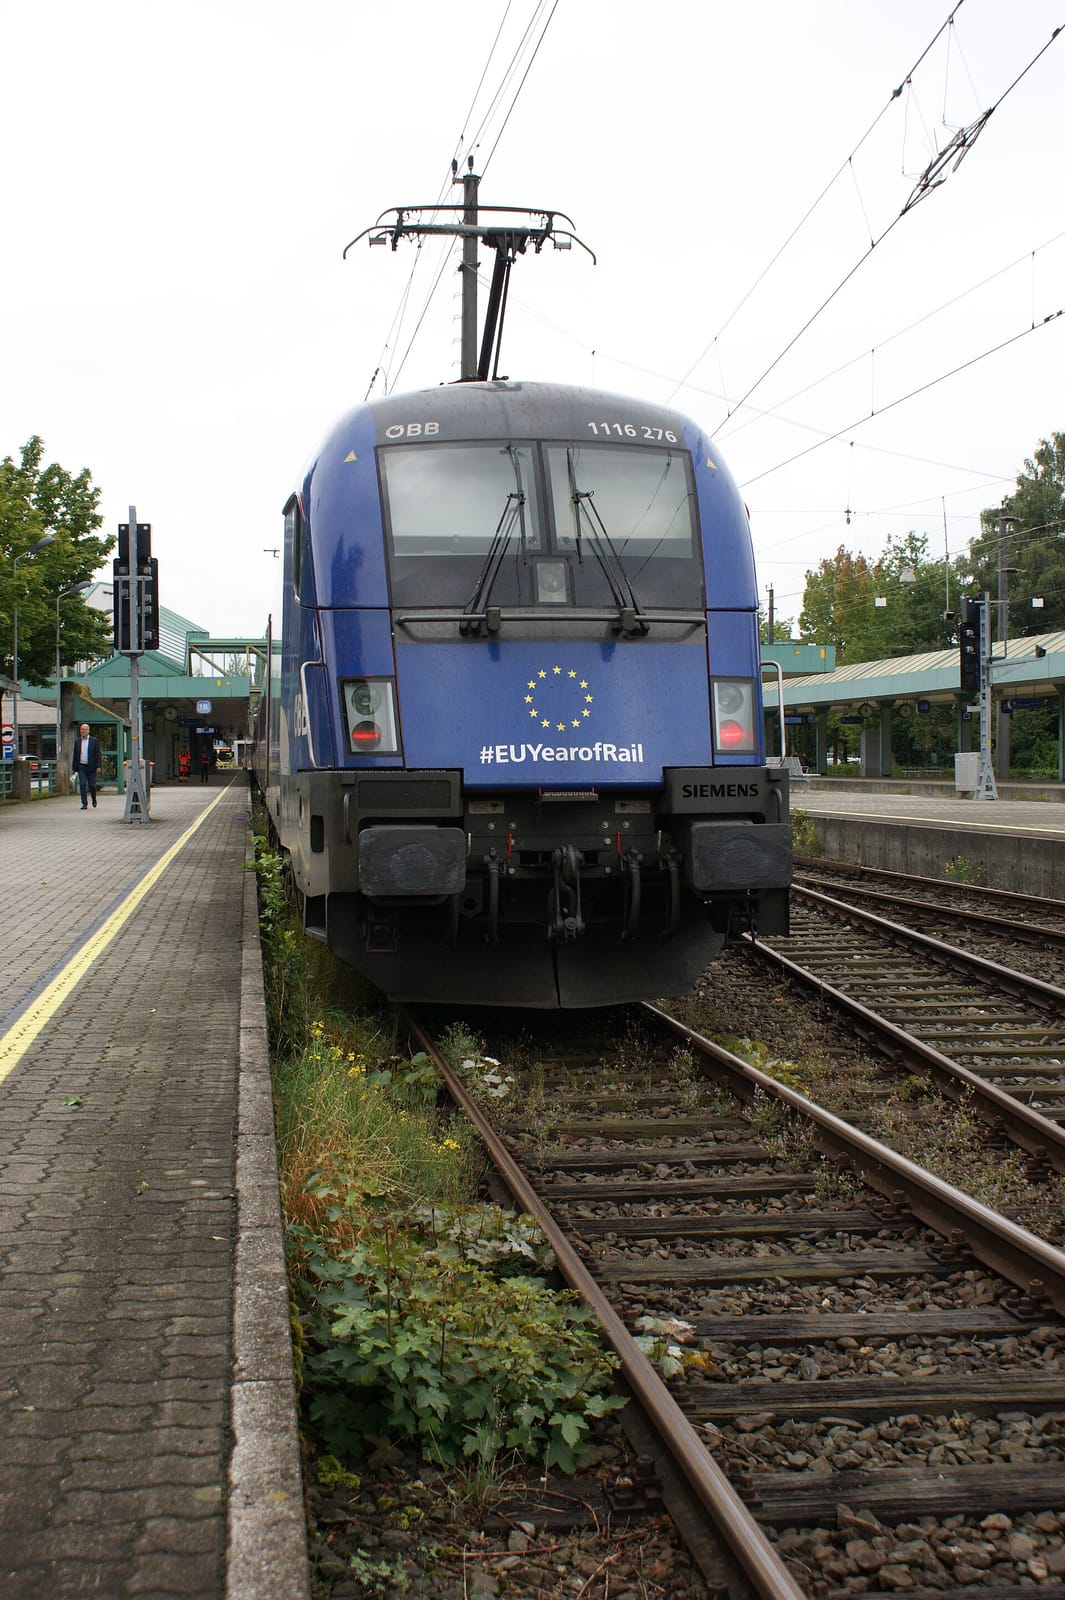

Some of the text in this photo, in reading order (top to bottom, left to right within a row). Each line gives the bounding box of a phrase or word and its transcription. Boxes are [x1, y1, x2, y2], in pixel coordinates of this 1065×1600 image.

[587, 422, 678, 443] 1116 276
[479, 742, 645, 764] #EUYearofRail
[682, 783, 760, 798] SIEMENS
